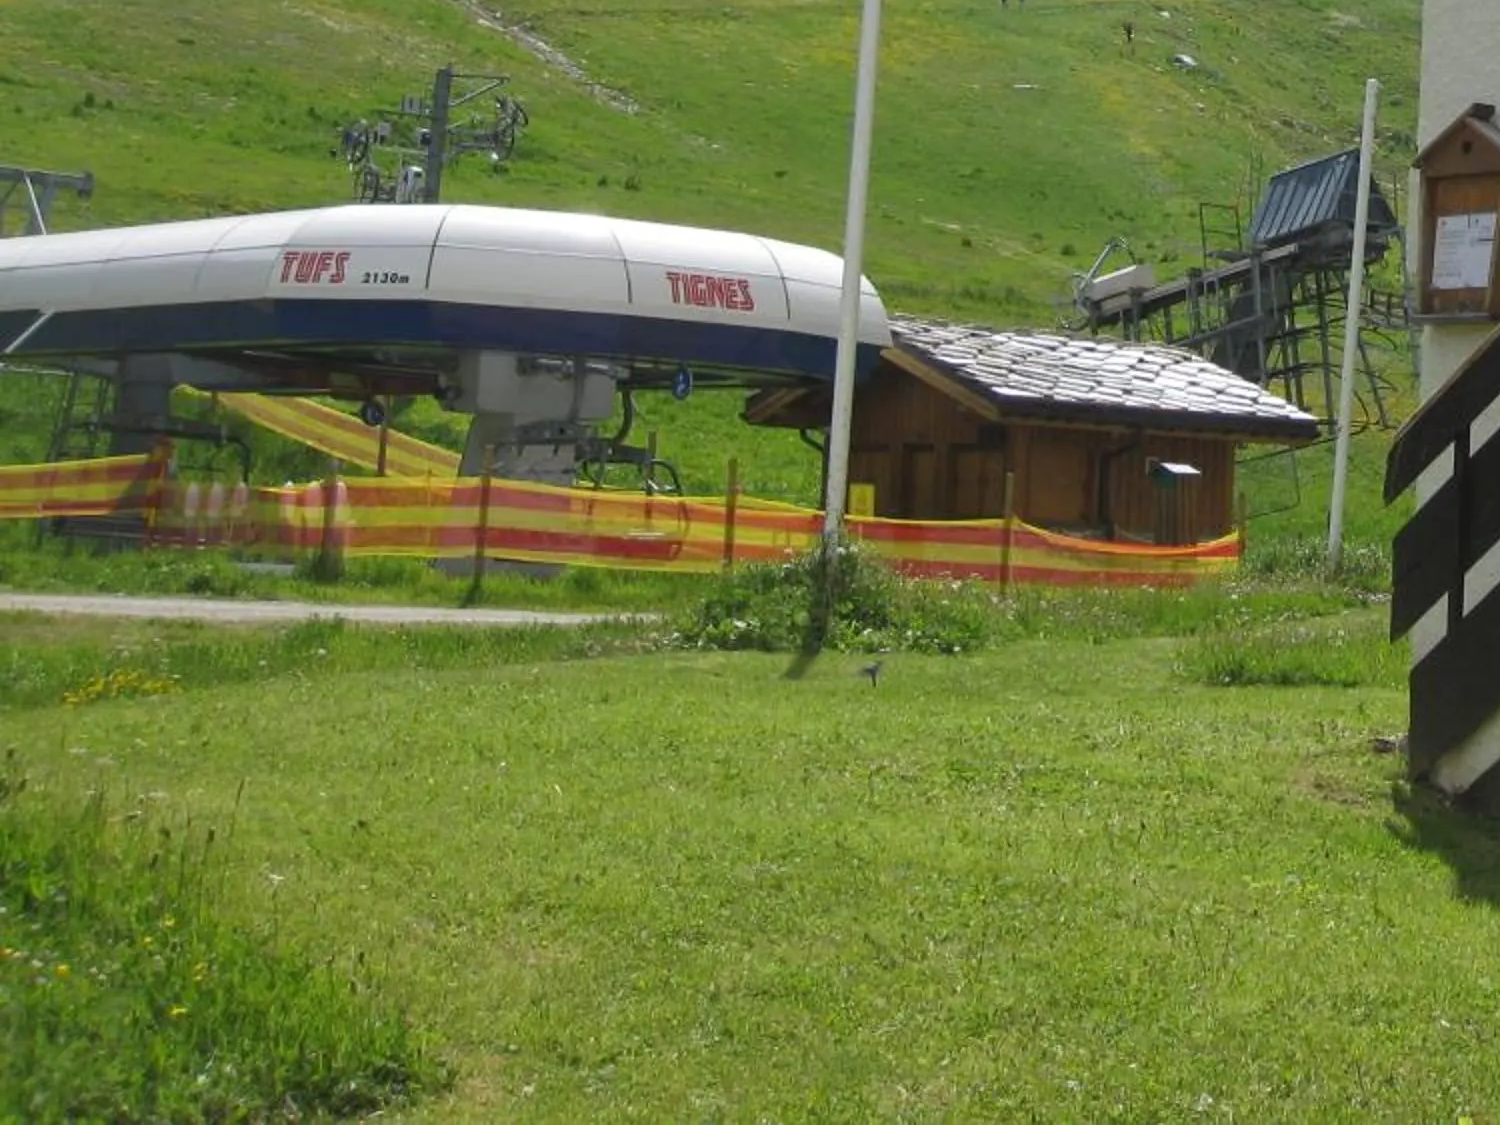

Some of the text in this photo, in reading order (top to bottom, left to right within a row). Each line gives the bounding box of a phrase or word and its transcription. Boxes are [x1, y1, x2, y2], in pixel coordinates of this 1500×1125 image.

[279, 250, 410, 284] TUFS 2130m
[666, 271, 755, 311] TIGNES
